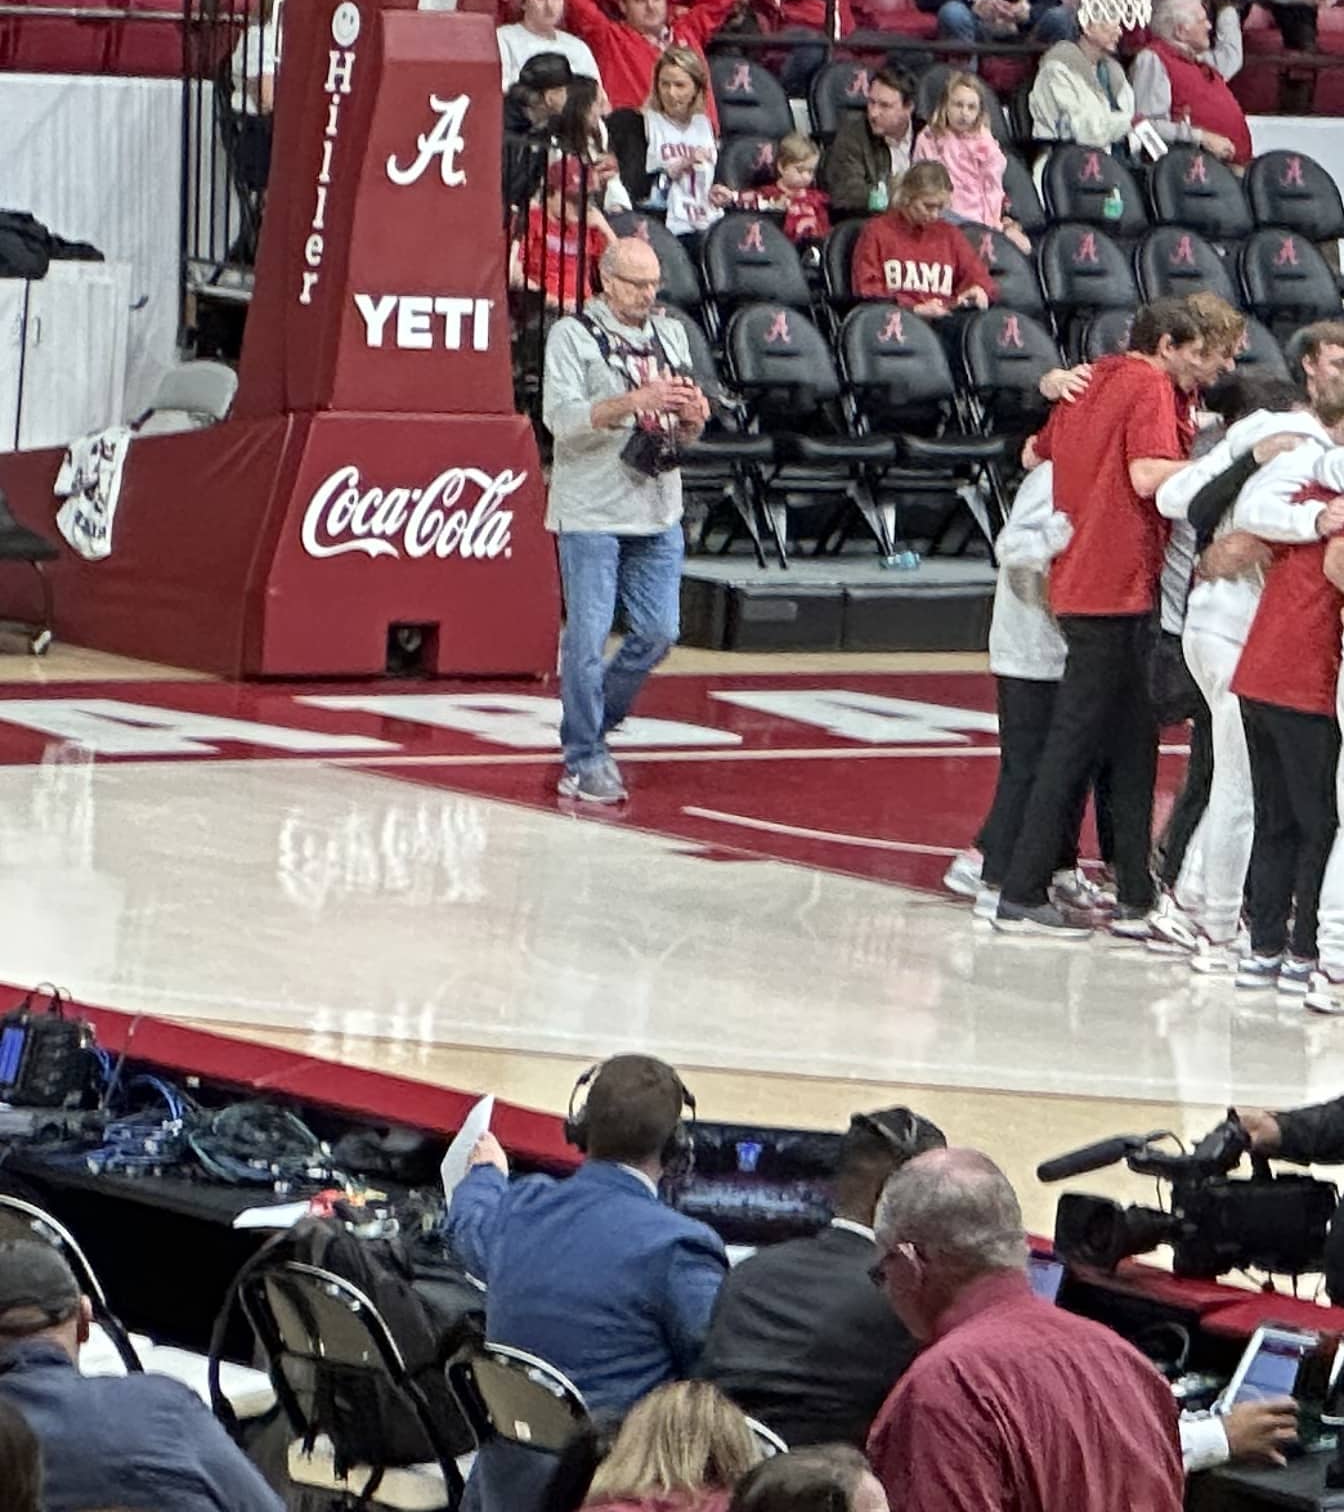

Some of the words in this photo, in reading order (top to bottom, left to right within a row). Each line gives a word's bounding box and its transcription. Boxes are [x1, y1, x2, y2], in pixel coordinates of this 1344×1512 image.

[299, 50, 356, 305] Hiller
[386, 93, 470, 187] A
[353, 293, 490, 352] YETI
[883, 257, 955, 296] BAMA
[301, 465, 528, 560] Coca-Cola
